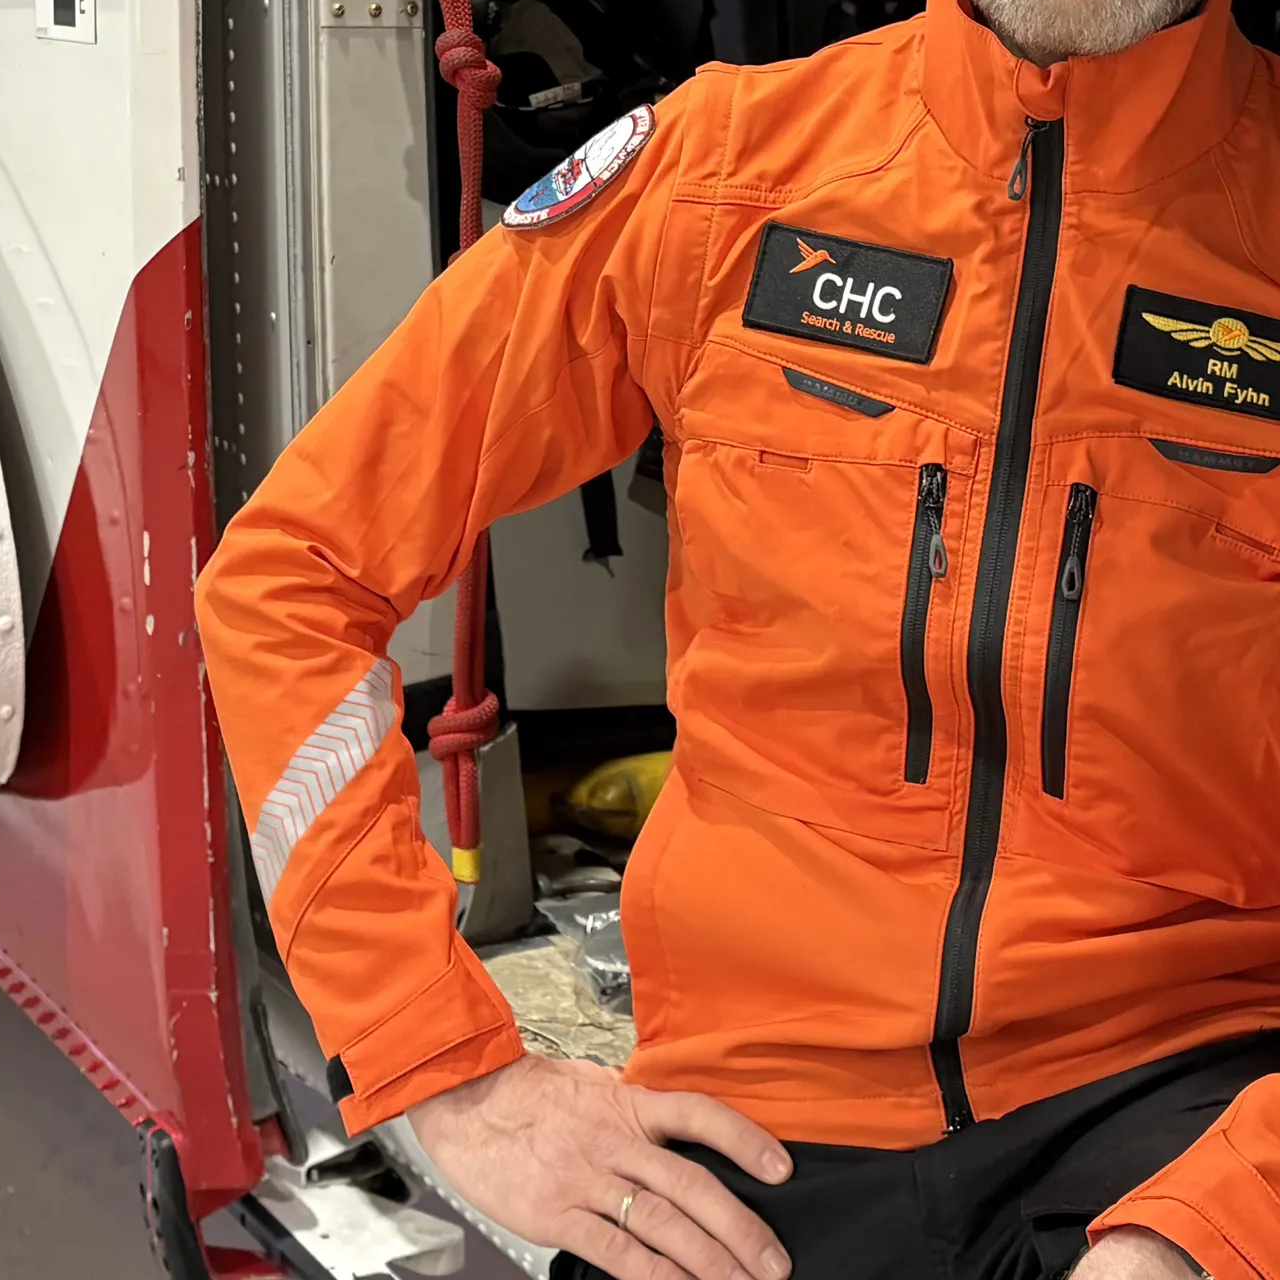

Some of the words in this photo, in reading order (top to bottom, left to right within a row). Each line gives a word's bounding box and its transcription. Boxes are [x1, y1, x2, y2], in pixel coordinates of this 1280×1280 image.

[812, 272, 902, 324] CHC
[800, 311, 840, 332] Search
[842, 320, 853, 334] &
[854, 323, 896, 345] Rescue
[1207, 358, 1239, 379] RM
[1167, 371, 1214, 395] Alvin
[1223, 382, 1271, 407] Fyhn
